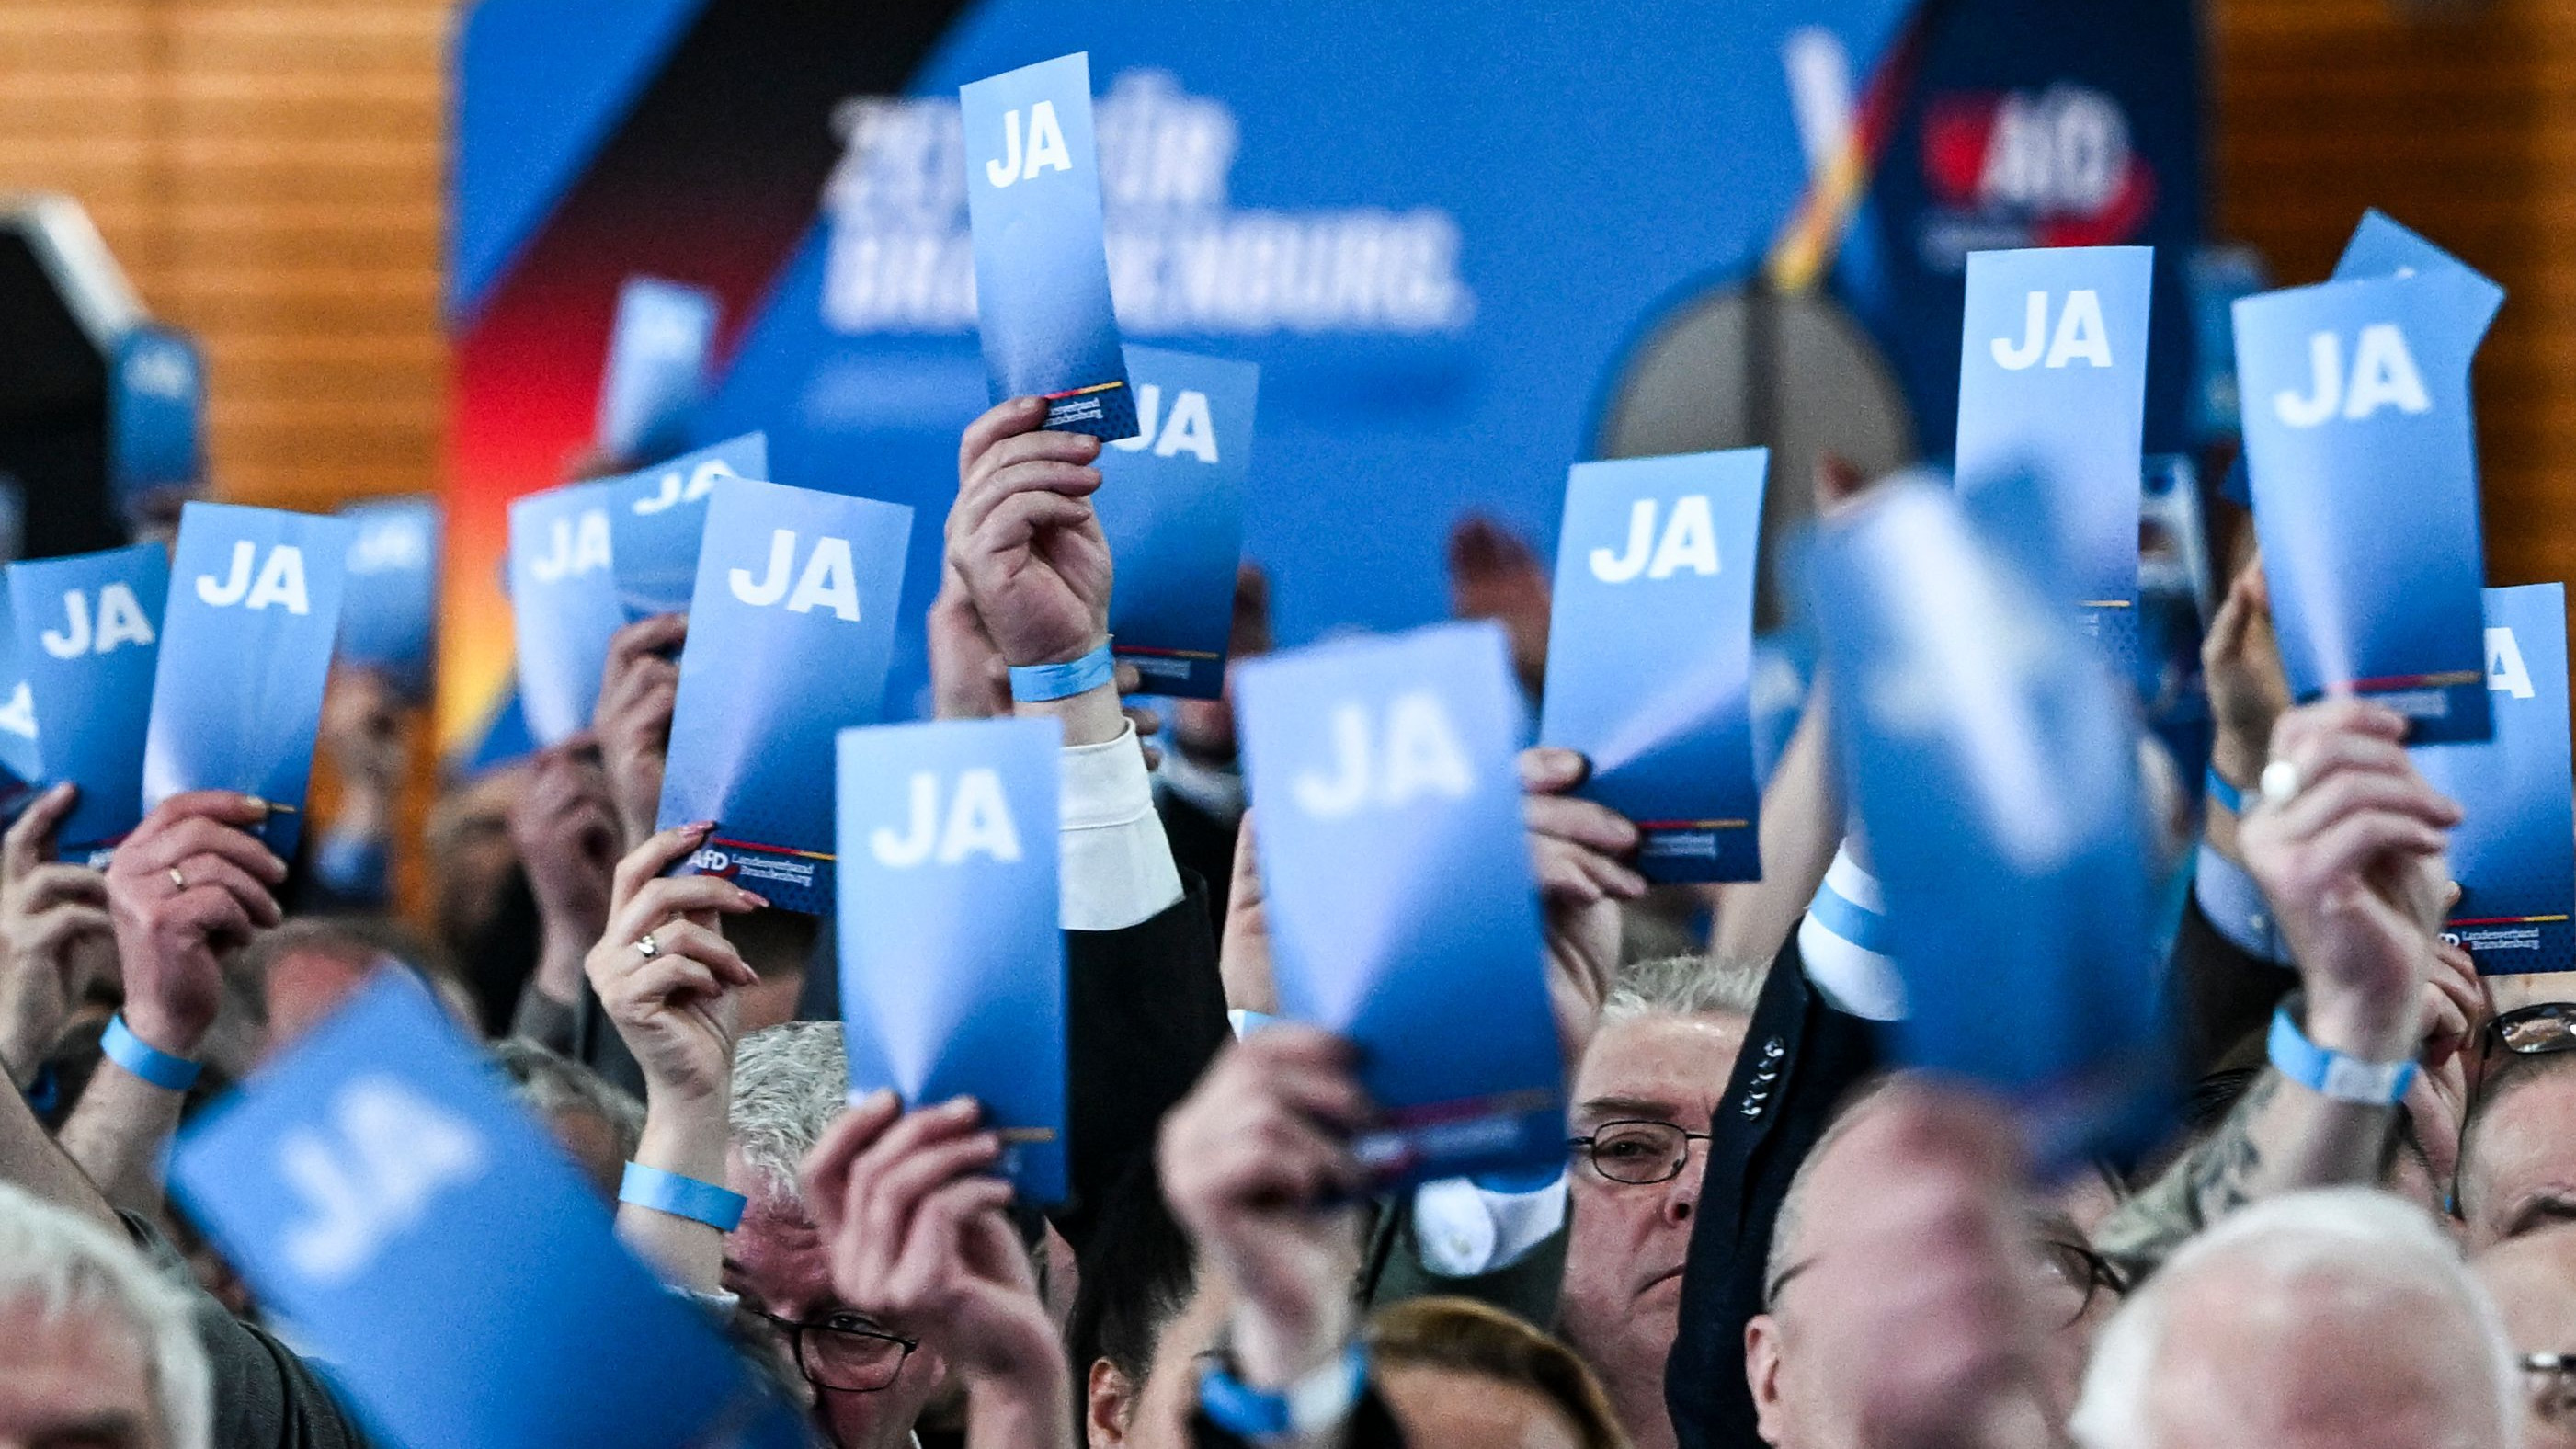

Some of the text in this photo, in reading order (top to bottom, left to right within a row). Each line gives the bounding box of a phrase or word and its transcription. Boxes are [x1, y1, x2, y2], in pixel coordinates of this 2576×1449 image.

[986, 100, 1073, 188] JA
[1990, 290, 2113, 370] JA
[2274, 324, 2432, 428] JA
[1109, 383, 1219, 463] JA
[195, 540, 310, 615] JA
[531, 508, 610, 585] JA
[727, 527, 861, 622] JA
[1590, 495, 1721, 583] JA
[40, 582, 155, 661] JA
[2485, 626, 2536, 699] A
[0, 681, 40, 740] A
[1294, 692, 1472, 819] JA
[871, 769, 1021, 868] JA
[688, 849, 729, 871] AfD
[276, 1072, 486, 1280] JA
